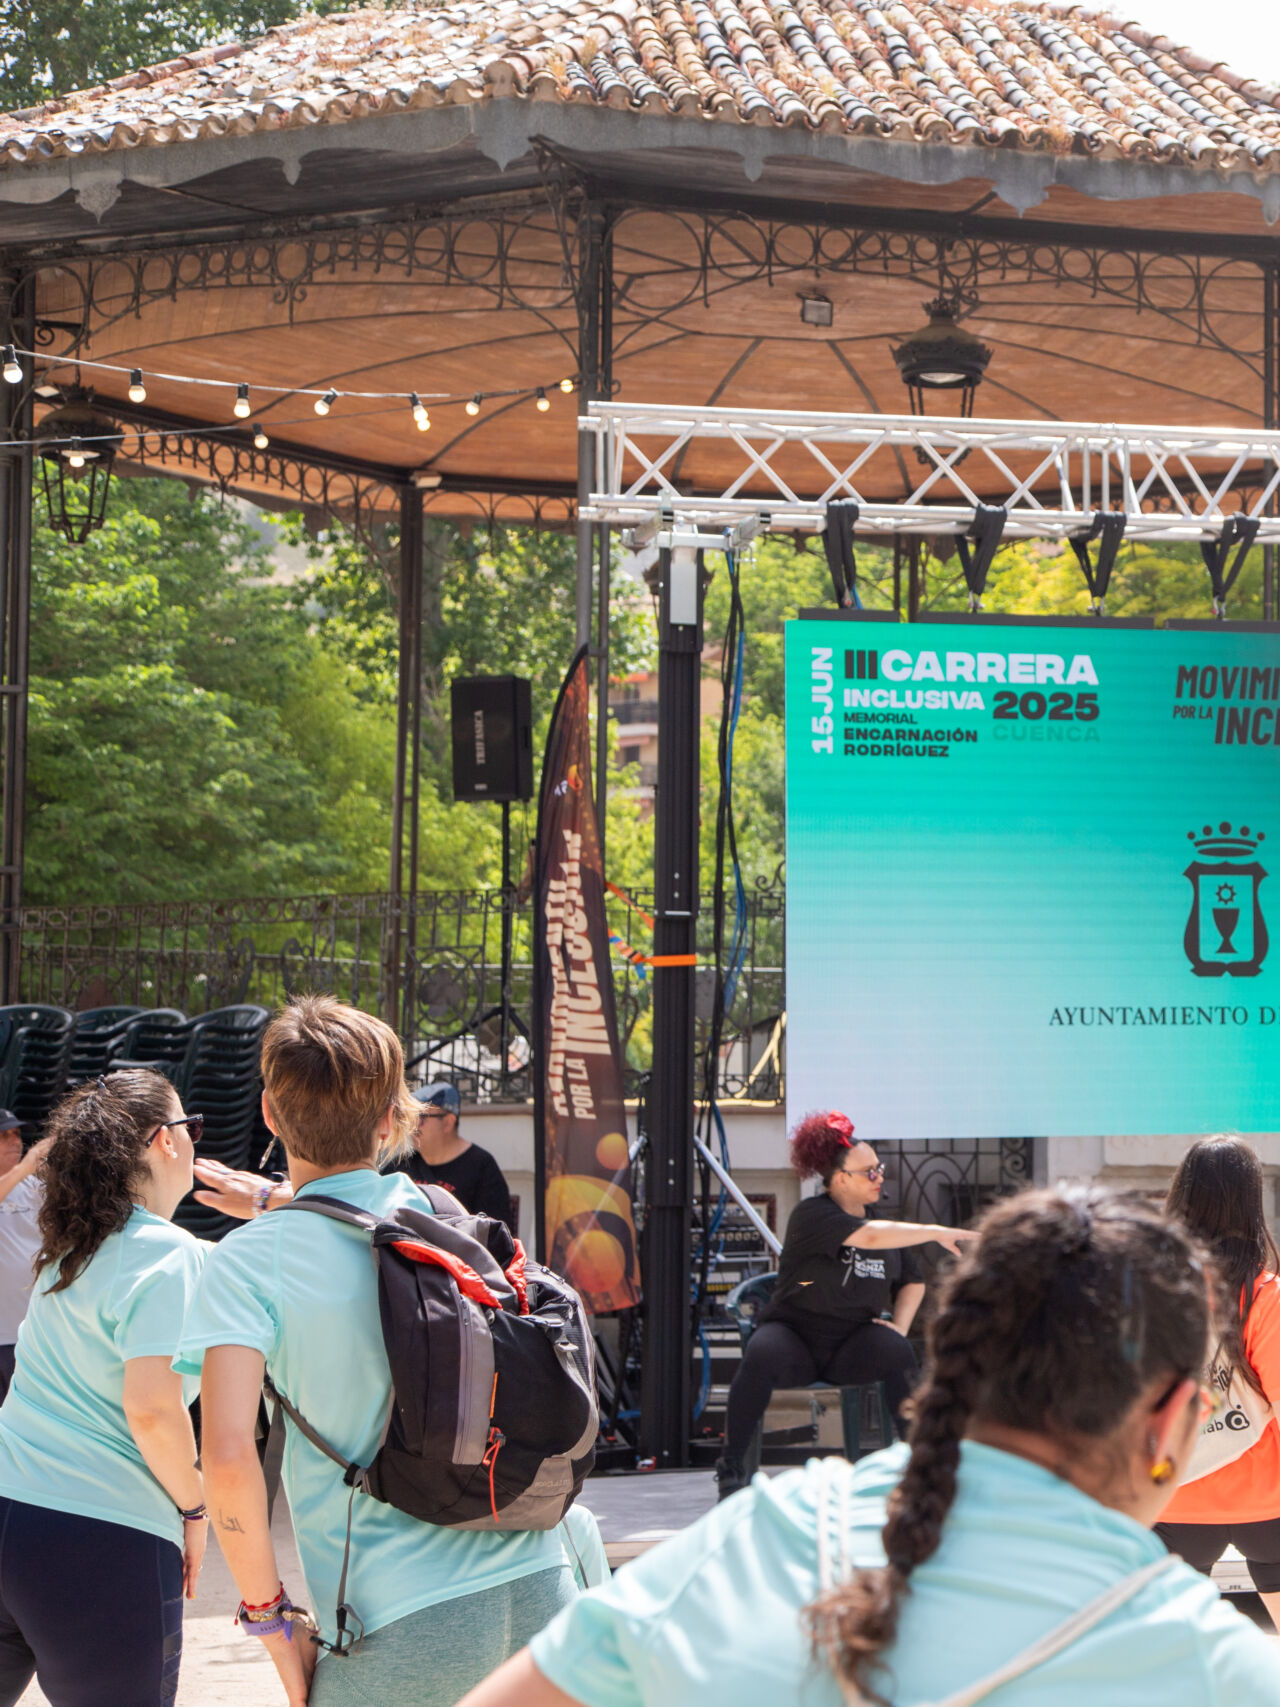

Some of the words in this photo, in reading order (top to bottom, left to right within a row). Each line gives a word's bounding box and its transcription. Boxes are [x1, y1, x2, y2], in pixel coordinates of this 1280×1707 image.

[881, 649, 1099, 685] CARRERA
[843, 688, 985, 710] INCLUSIVA
[993, 691, 1100, 721] 2025
[844, 712, 917, 725] MEMORIAL
[1173, 705, 1196, 719] POR
[1198, 707, 1213, 719] LA
[844, 727, 978, 742] ENCARNACIÓN
[993, 724, 1100, 742] CUENCA
[844, 743, 949, 757] RODRÍGUEZ
[1050, 1006, 1248, 1025] AYUNTAMIENTO
[565, 1057, 587, 1082] LA
[573, 1080, 597, 1121] POR
